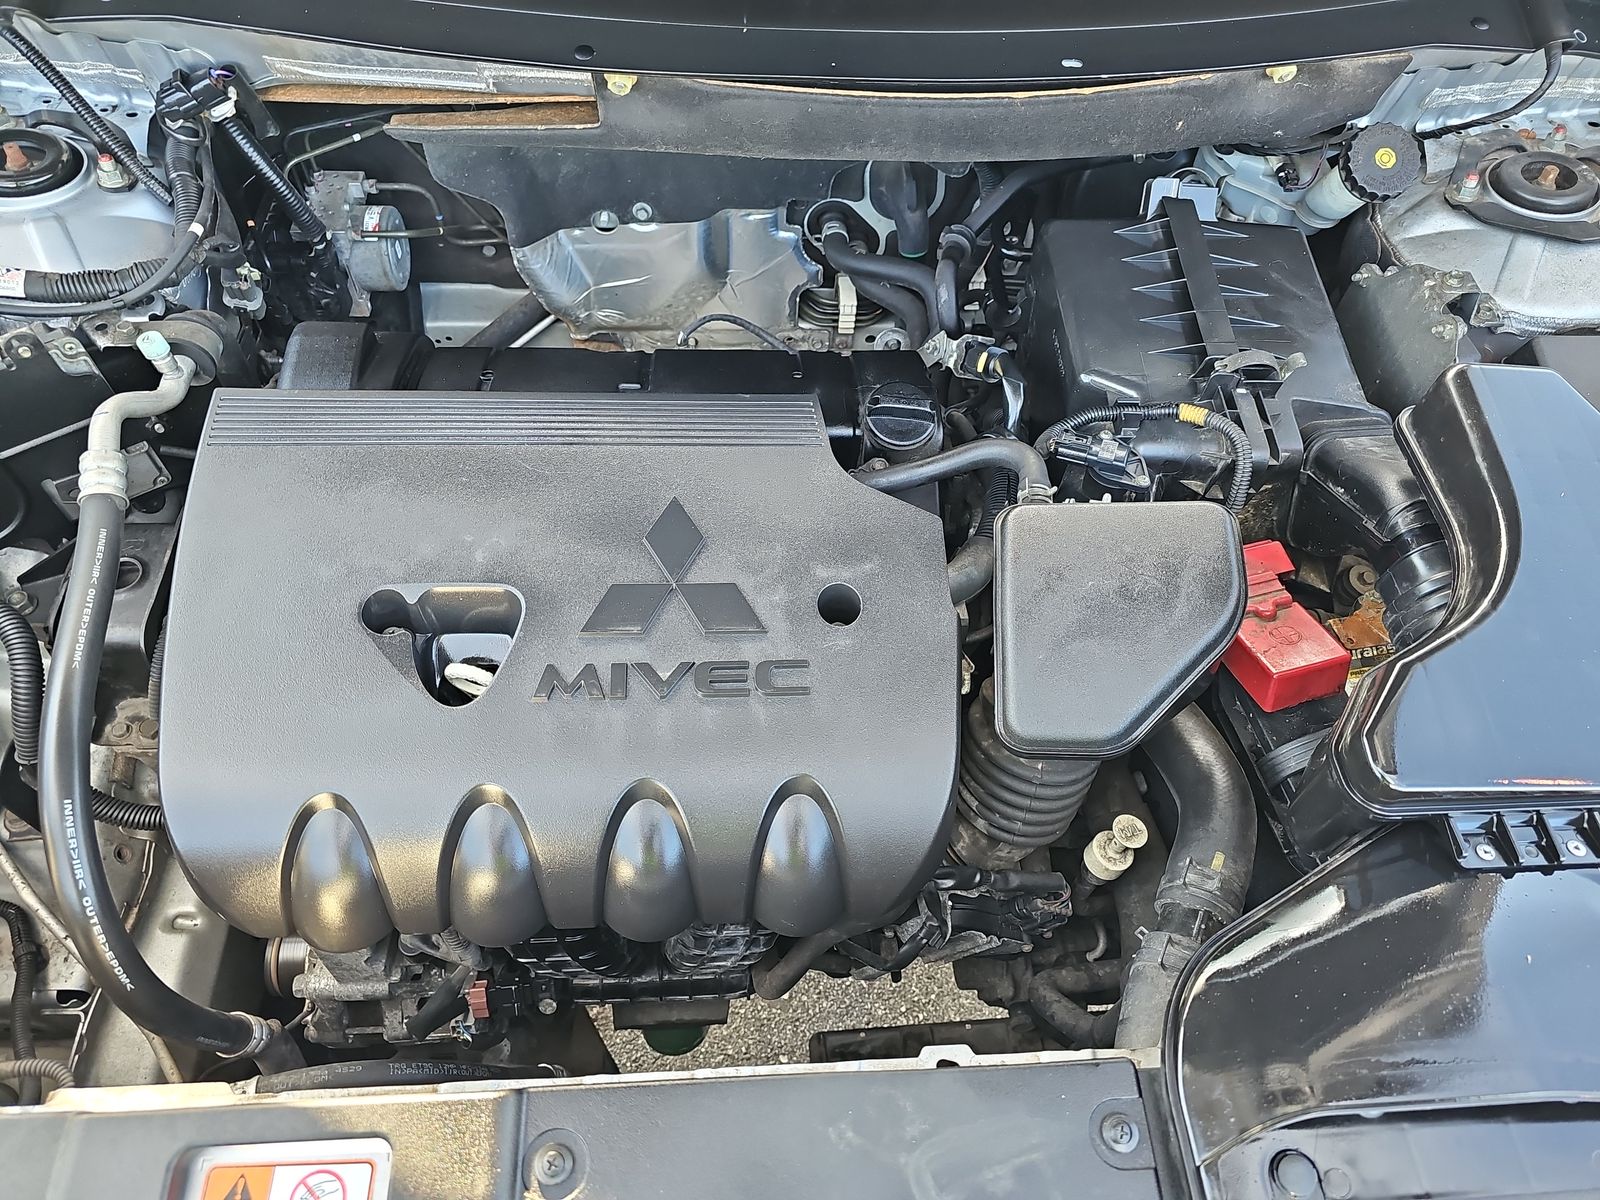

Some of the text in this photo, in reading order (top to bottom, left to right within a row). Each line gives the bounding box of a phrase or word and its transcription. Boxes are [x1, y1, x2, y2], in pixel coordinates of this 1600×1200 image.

[72, 528, 107, 669] INNER>IIR< OUTER>EPDM<
[531, 659, 811, 701] MIVEC
[63, 799, 136, 992] INNER>IIR< OUTER>EPDM<
